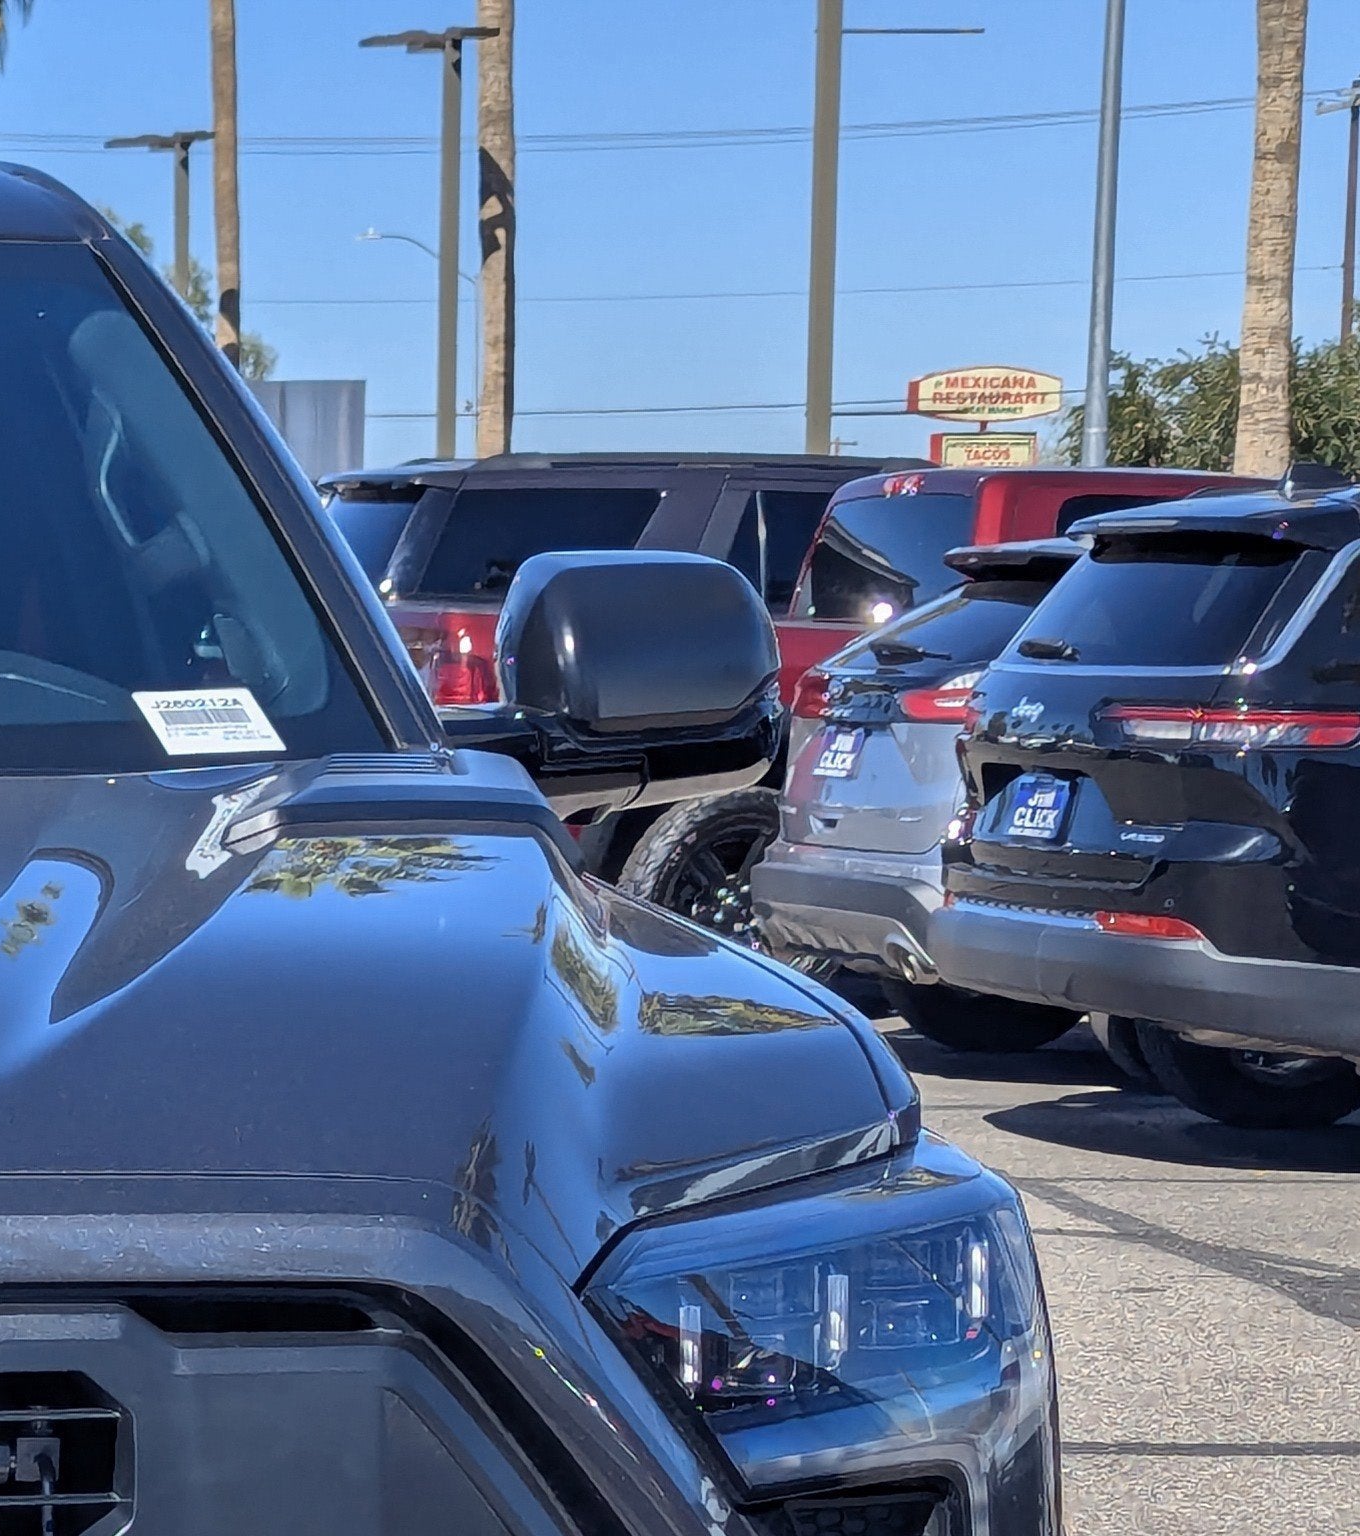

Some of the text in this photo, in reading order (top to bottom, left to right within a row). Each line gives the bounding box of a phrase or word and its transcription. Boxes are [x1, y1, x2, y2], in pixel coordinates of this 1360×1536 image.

[945, 376, 1037, 389] MEXICANA
[932, 391, 1048, 405] RESTAURANT
[965, 447, 1011, 461] TACOS
[1014, 807, 1059, 829] CLICK
